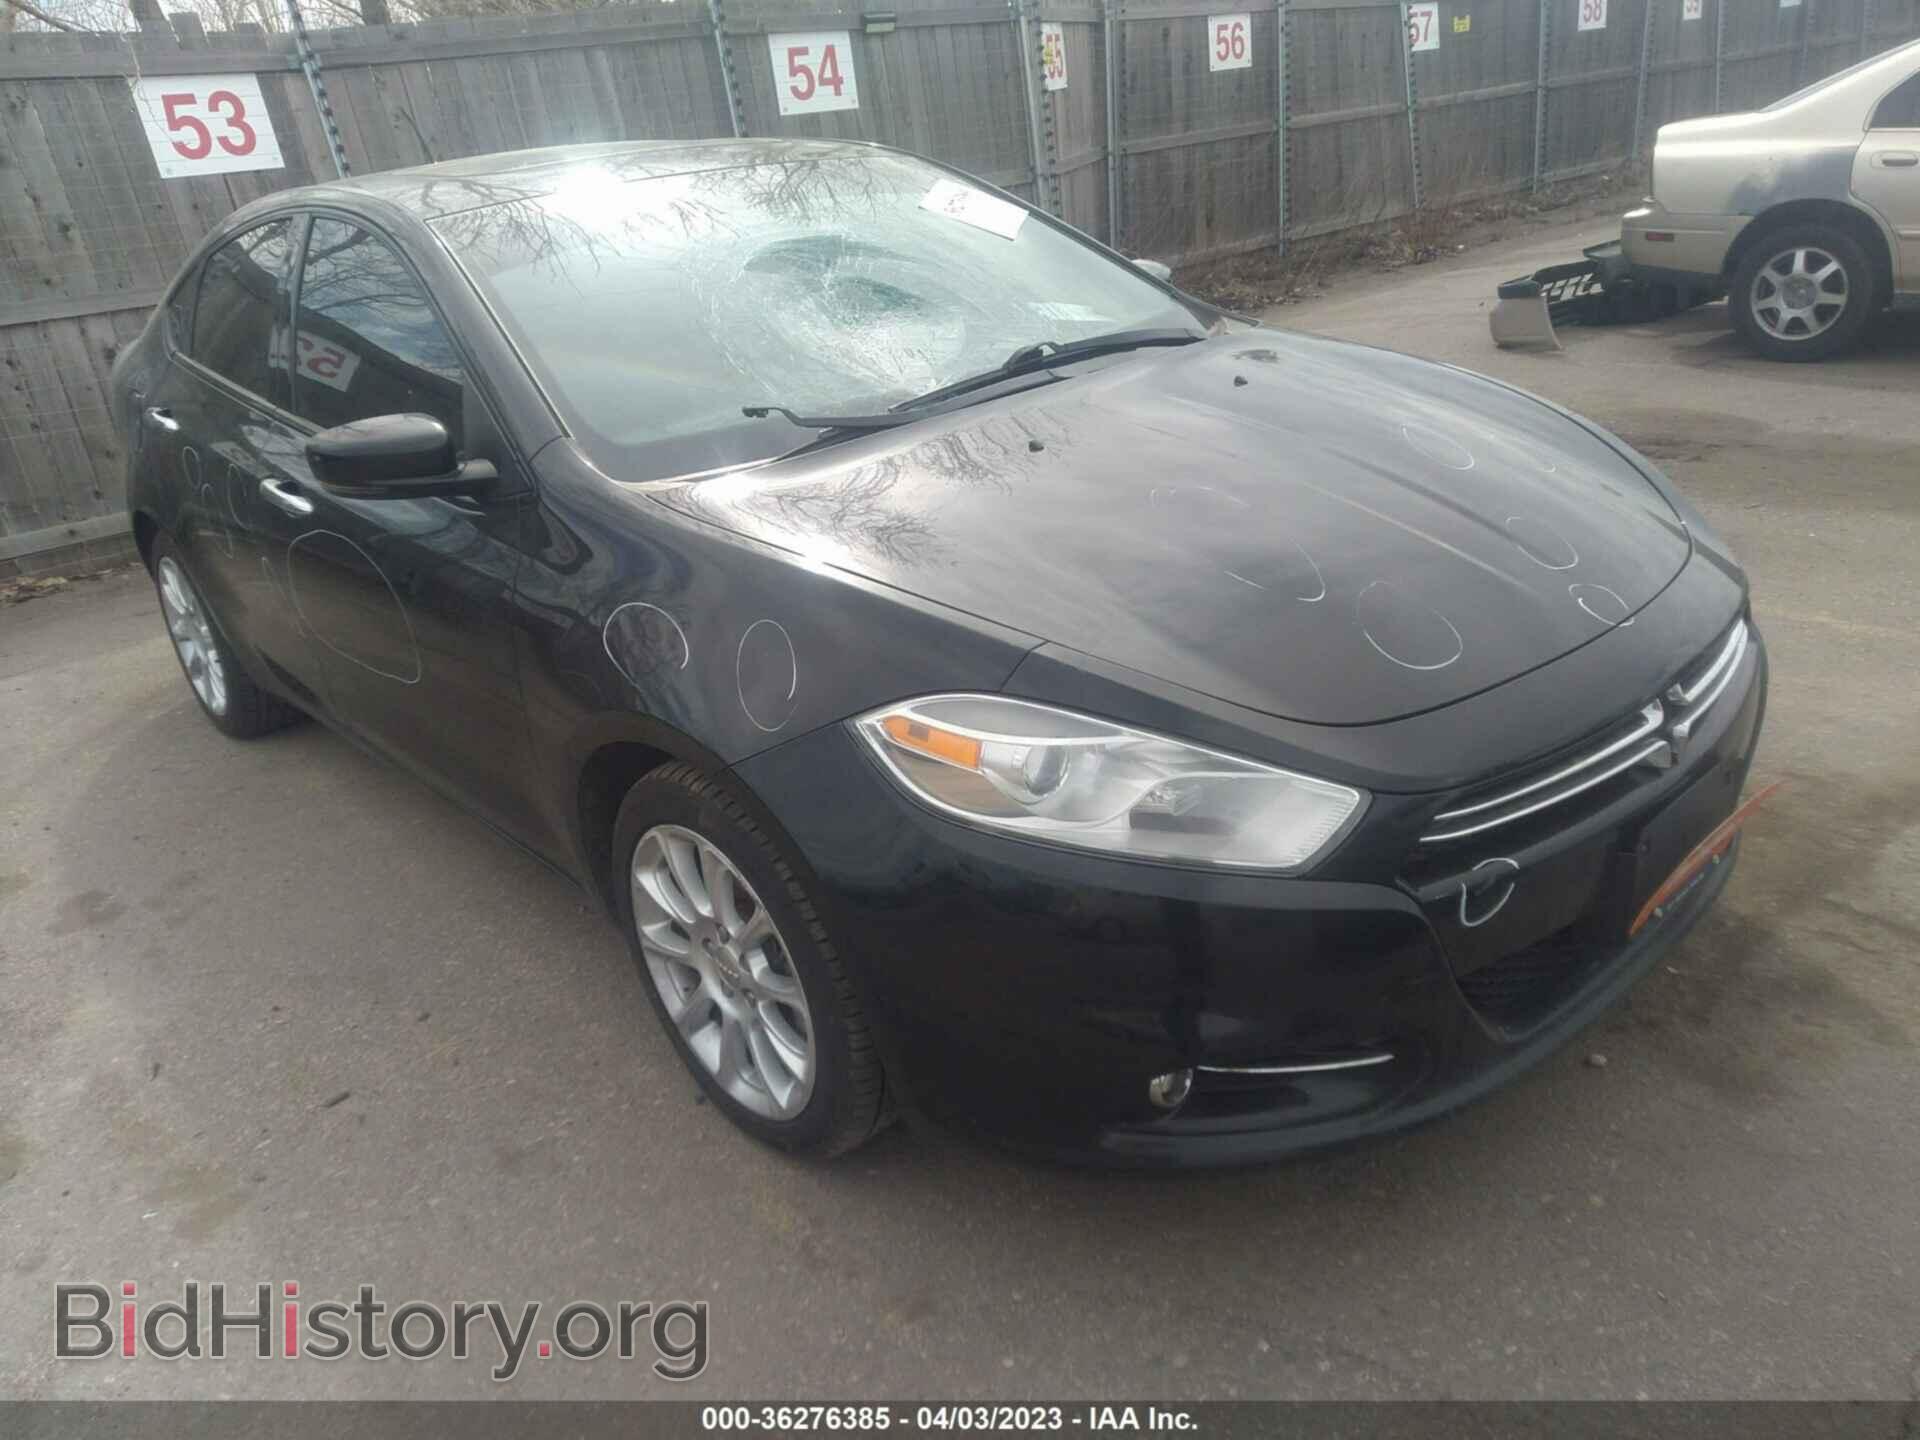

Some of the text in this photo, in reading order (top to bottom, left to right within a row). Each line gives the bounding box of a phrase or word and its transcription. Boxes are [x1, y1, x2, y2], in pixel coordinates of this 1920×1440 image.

[1216, 22, 1244, 61] 56
[1408, 11, 1432, 43] 57
[787, 44, 844, 101] 54
[1046, 33, 1063, 79] 55
[161, 90, 257, 160] 53
